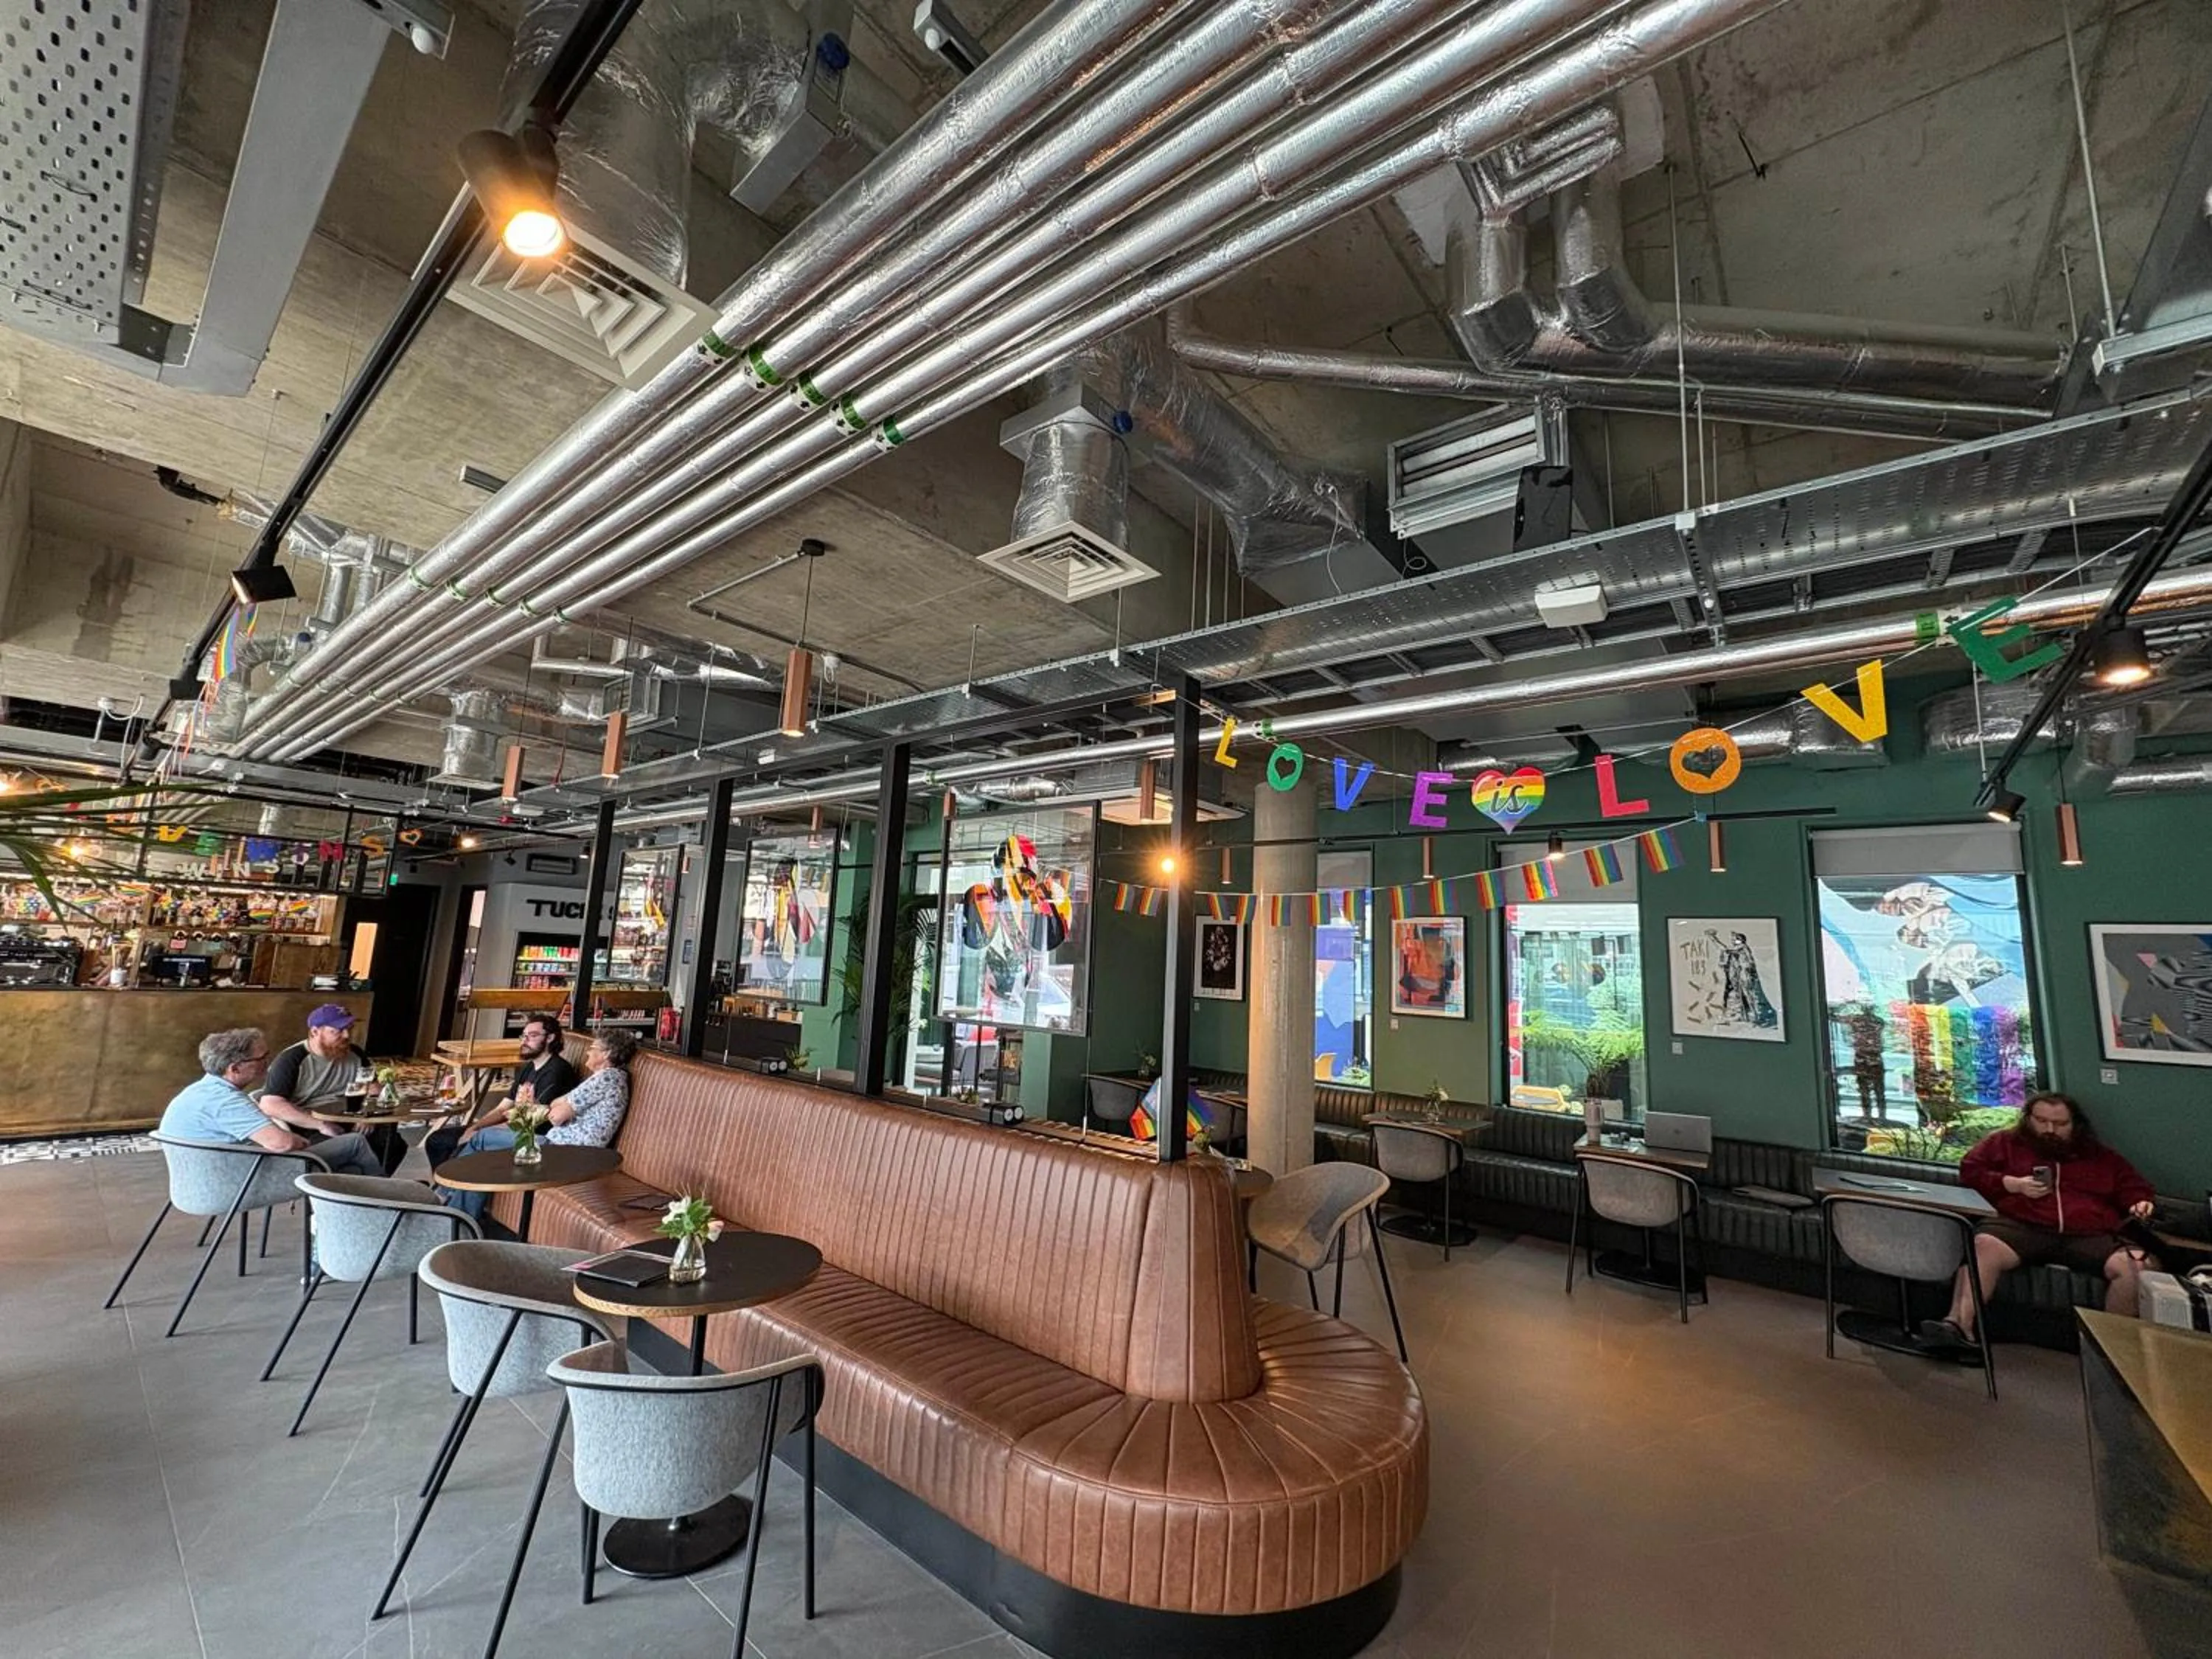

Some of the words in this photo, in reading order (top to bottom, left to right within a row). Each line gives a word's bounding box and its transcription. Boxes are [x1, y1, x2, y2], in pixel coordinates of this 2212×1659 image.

[1214, 717, 1454, 828] LOVE
[1490, 780, 1528, 814] is
[1594, 597, 2064, 818] LOVE
